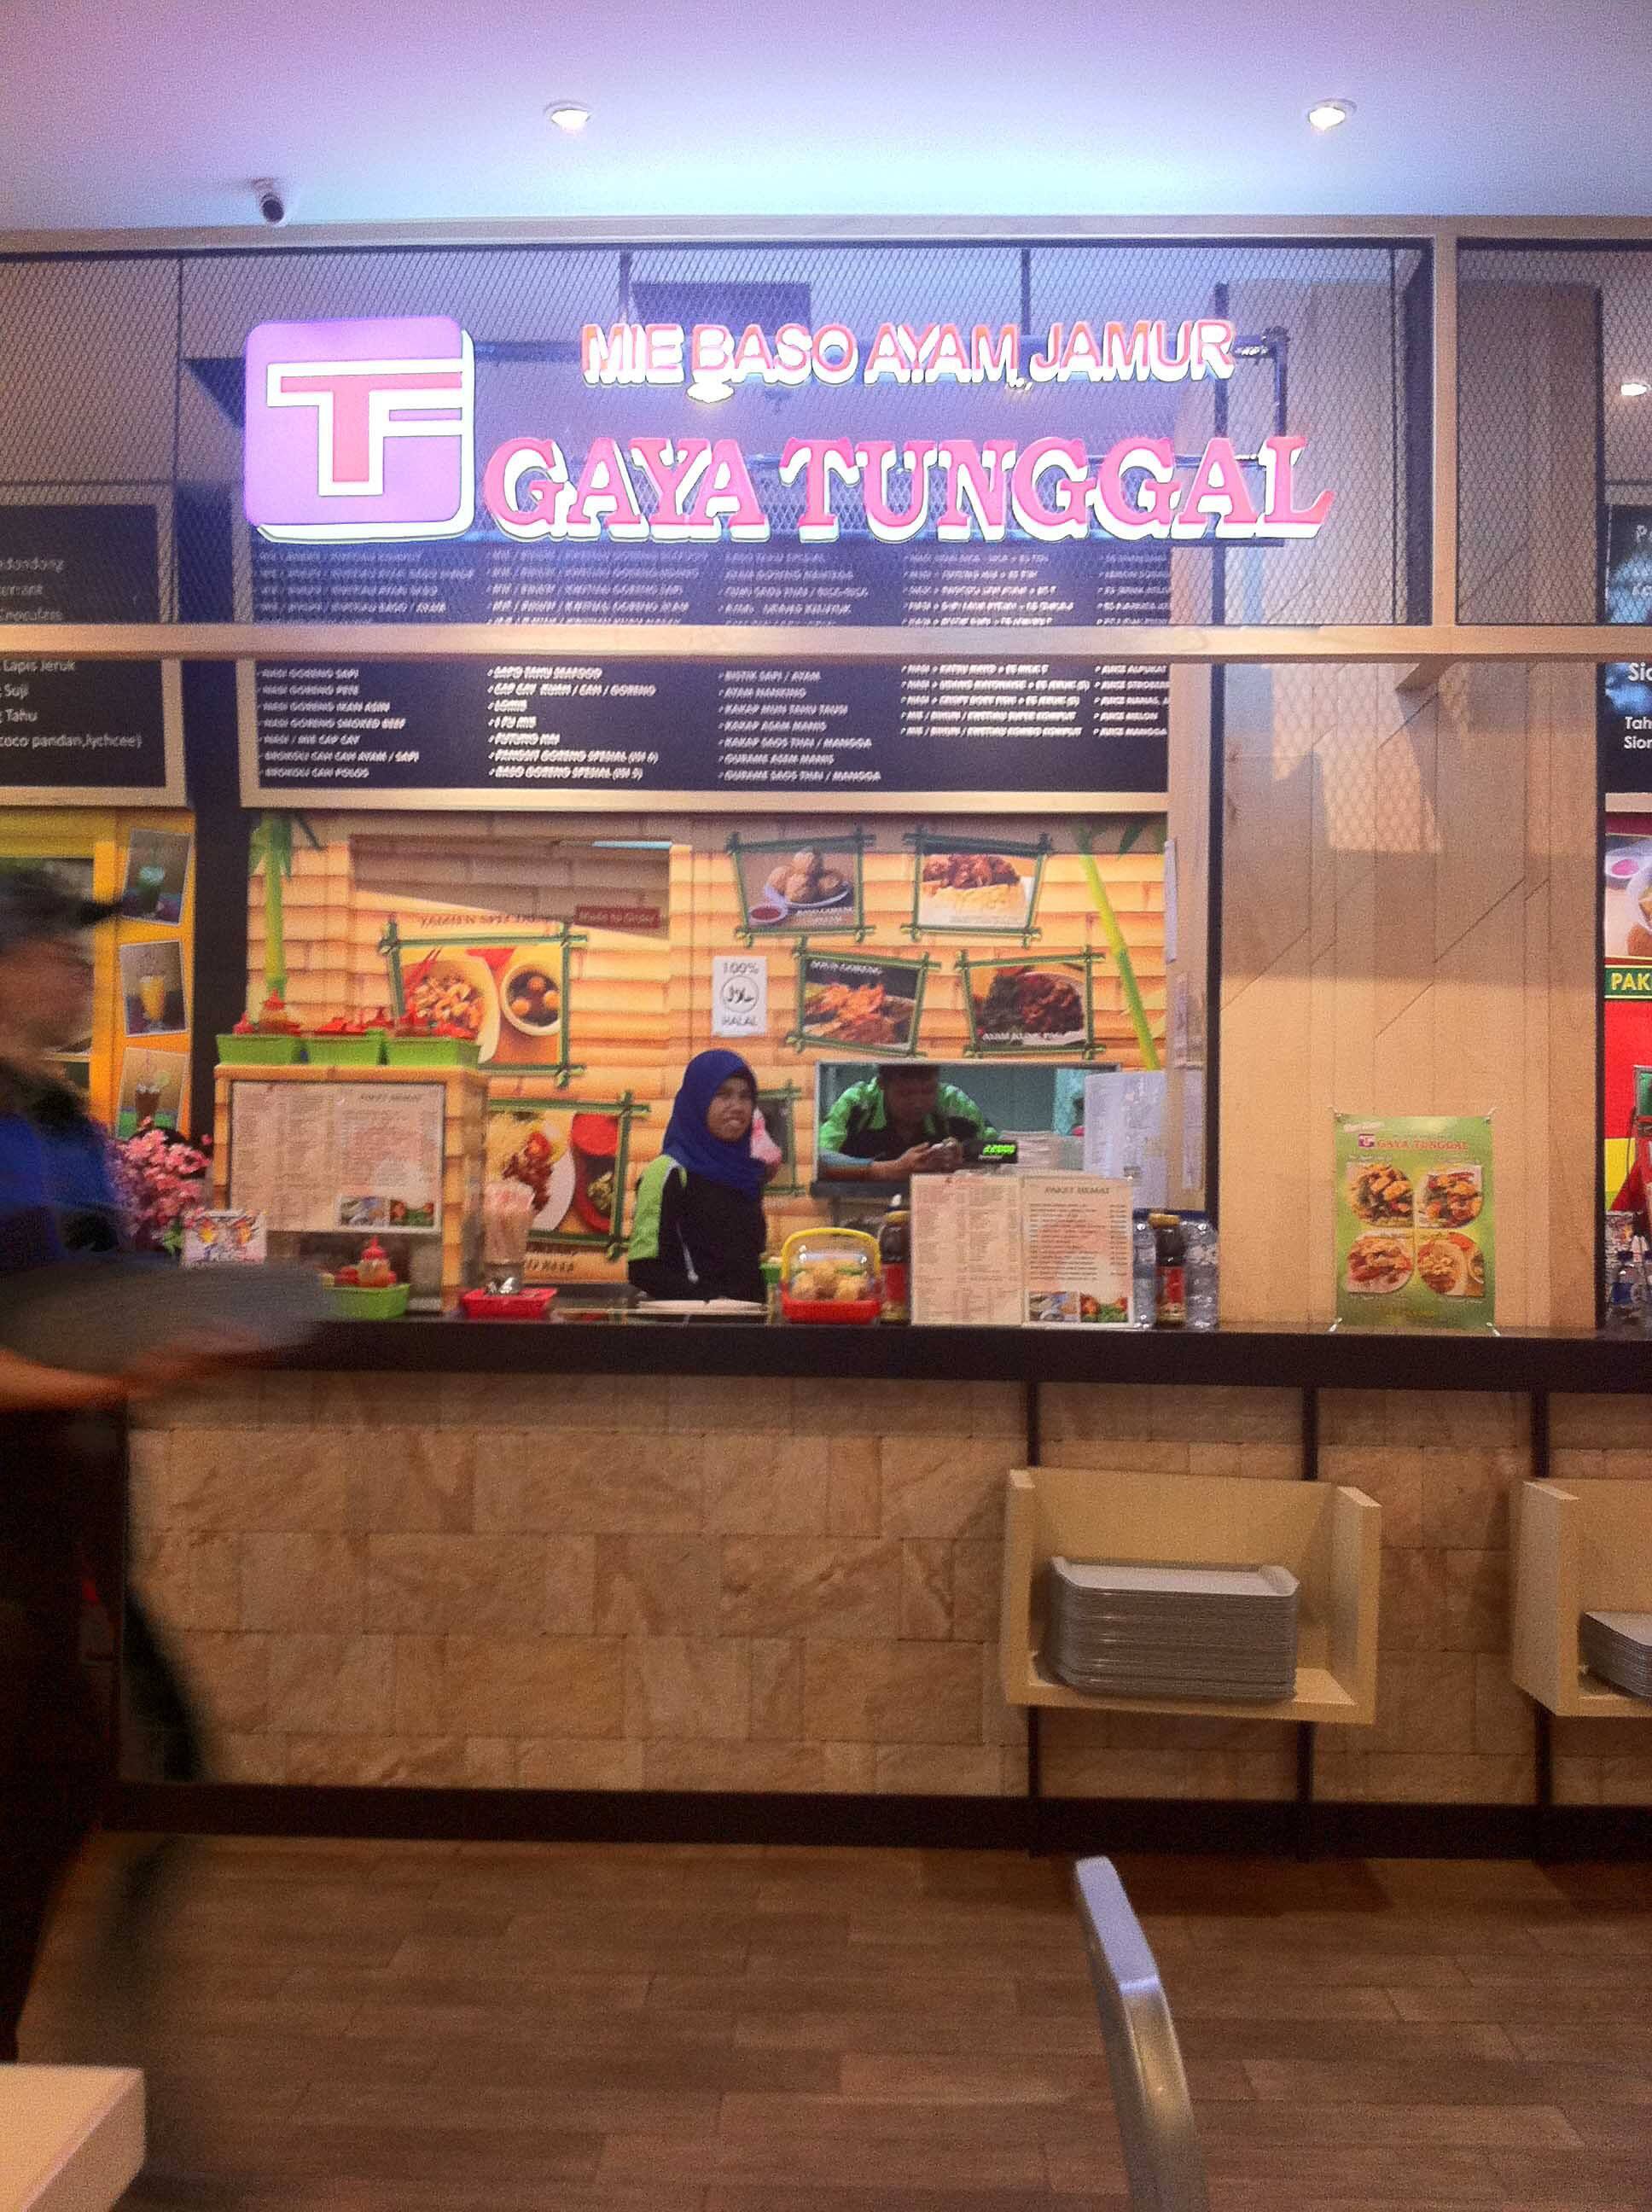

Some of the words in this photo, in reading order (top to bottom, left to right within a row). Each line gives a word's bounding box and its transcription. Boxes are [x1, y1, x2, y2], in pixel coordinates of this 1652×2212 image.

[581, 323, 685, 384] MIE
[691, 323, 858, 386] BASO
[864, 323, 1018, 384] AYAM
[1029, 319, 1236, 384] JAMUR
[483, 437, 771, 541] GAYA
[778, 436, 1334, 543] TUNGGAL
[5, 708, 38, 723] Tahu
[723, 962, 759, 974] 100%
[1611, 972, 1652, 991] PAK
[723, 1016, 758, 1026] HALAL
